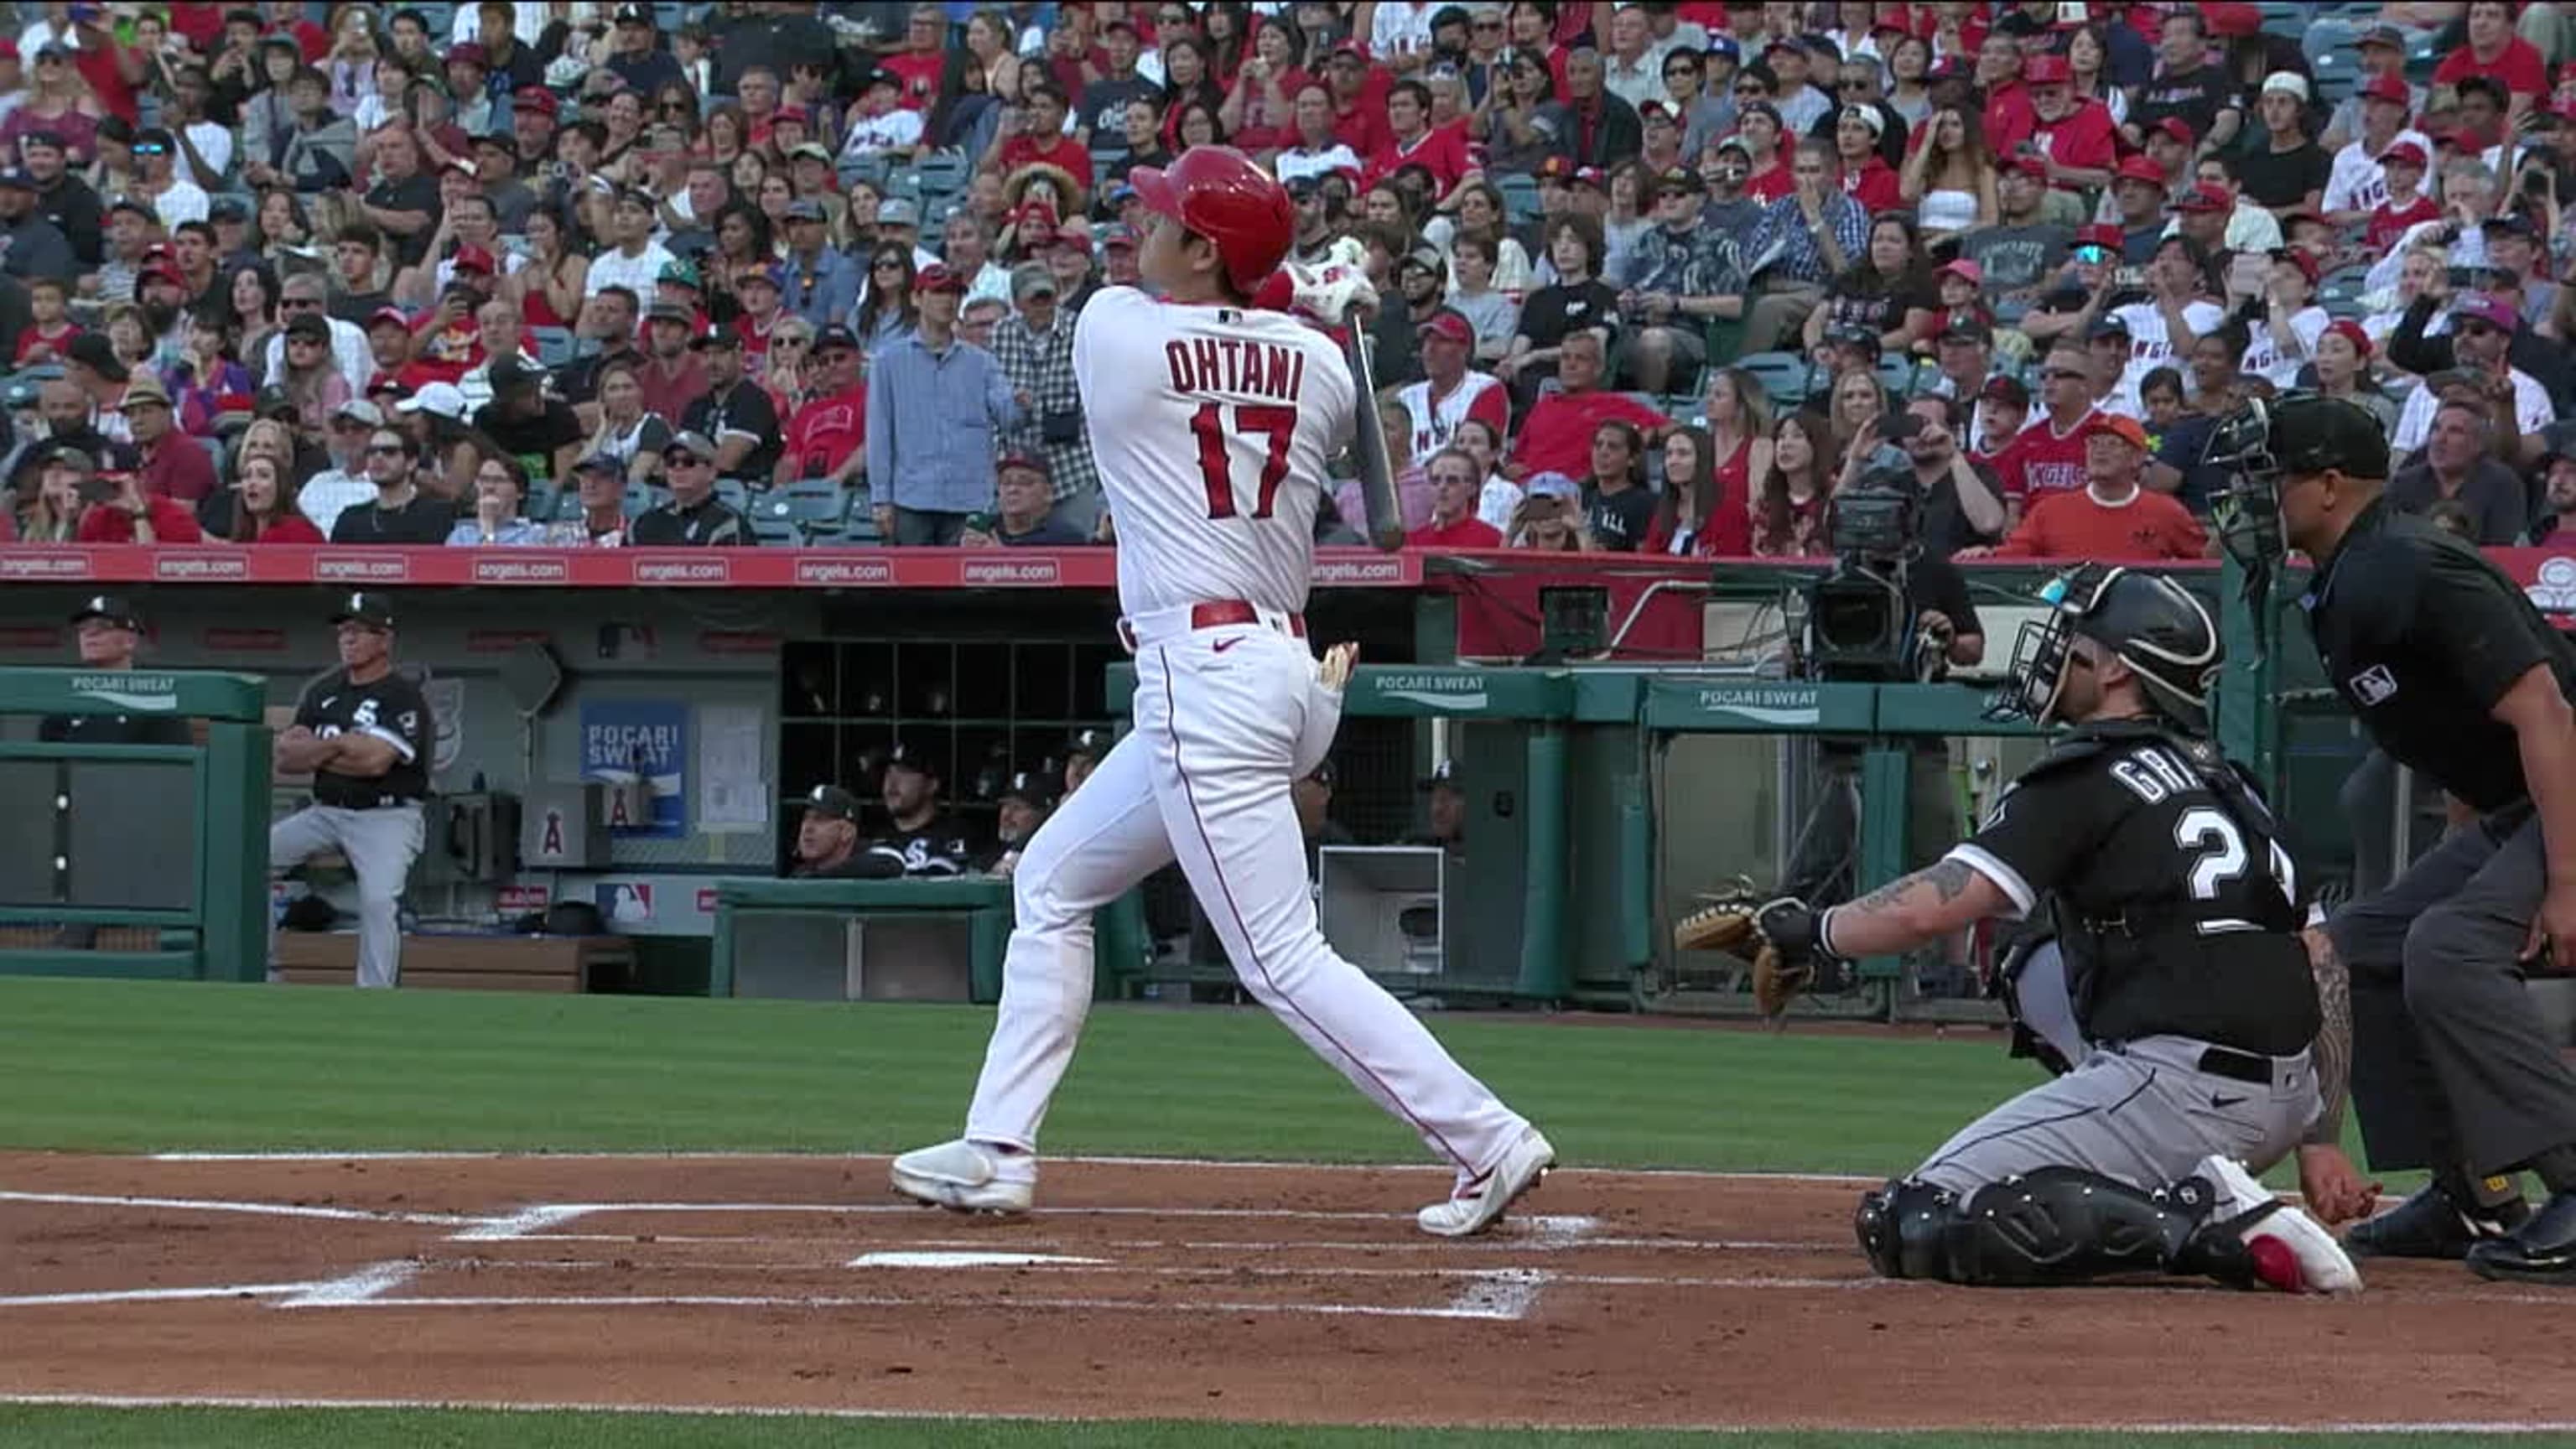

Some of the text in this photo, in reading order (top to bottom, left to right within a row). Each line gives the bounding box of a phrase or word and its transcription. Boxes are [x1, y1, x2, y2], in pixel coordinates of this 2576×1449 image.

[1165, 337, 1304, 402] OHTANI
[1189, 401, 1298, 520] 17
[158, 559, 245, 576] angels.com
[319, 560, 403, 577] angels.com
[478, 562, 564, 579] angels.com
[638, 562, 724, 579] angels.com
[800, 563, 887, 580] angels.com
[965, 563, 1055, 580] angels.com
[71, 677, 174, 691] POCARI SWEAT
[1375, 675, 1483, 690] POCARI SWEAT
[1700, 690, 1817, 705] POCARI SWEAT
[588, 725, 678, 745] POCARI
